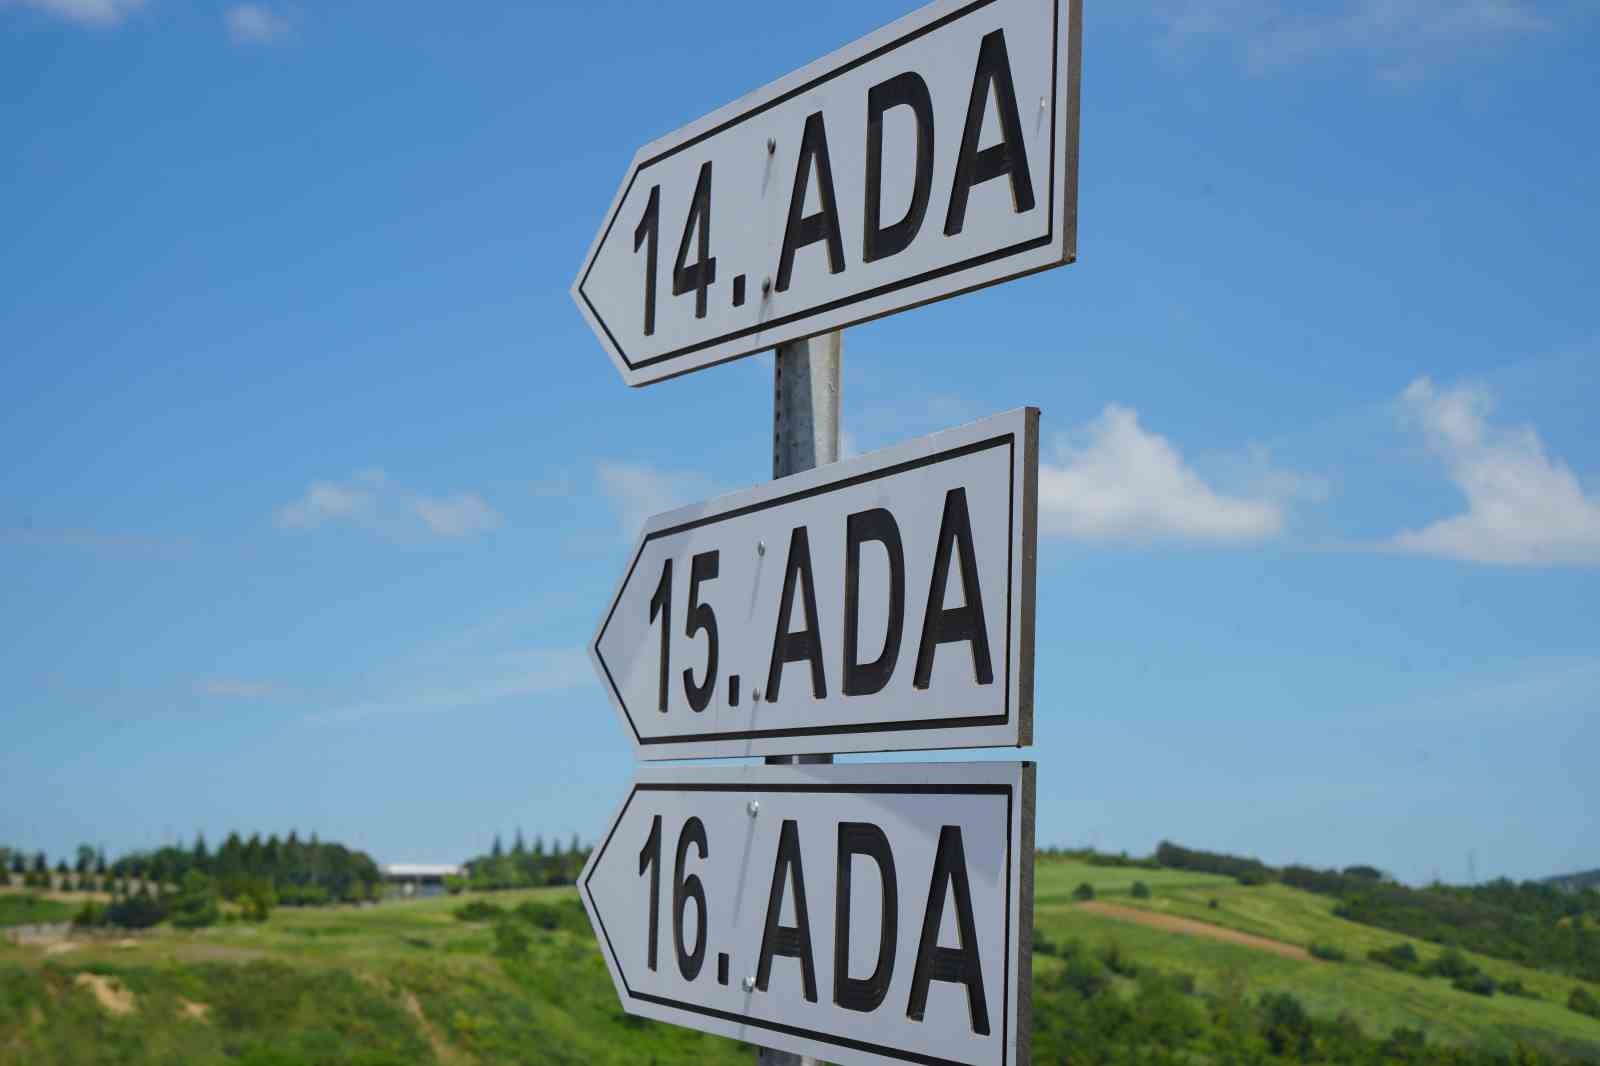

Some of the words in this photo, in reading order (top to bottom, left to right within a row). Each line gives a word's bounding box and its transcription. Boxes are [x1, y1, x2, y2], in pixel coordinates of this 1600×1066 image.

[633, 160, 746, 337] 14.
[774, 27, 1036, 293] ADA
[649, 549, 740, 714] 15.
[764, 486, 994, 704] ADA
[638, 814, 730, 986] 16.
[754, 819, 991, 1037] ADA
